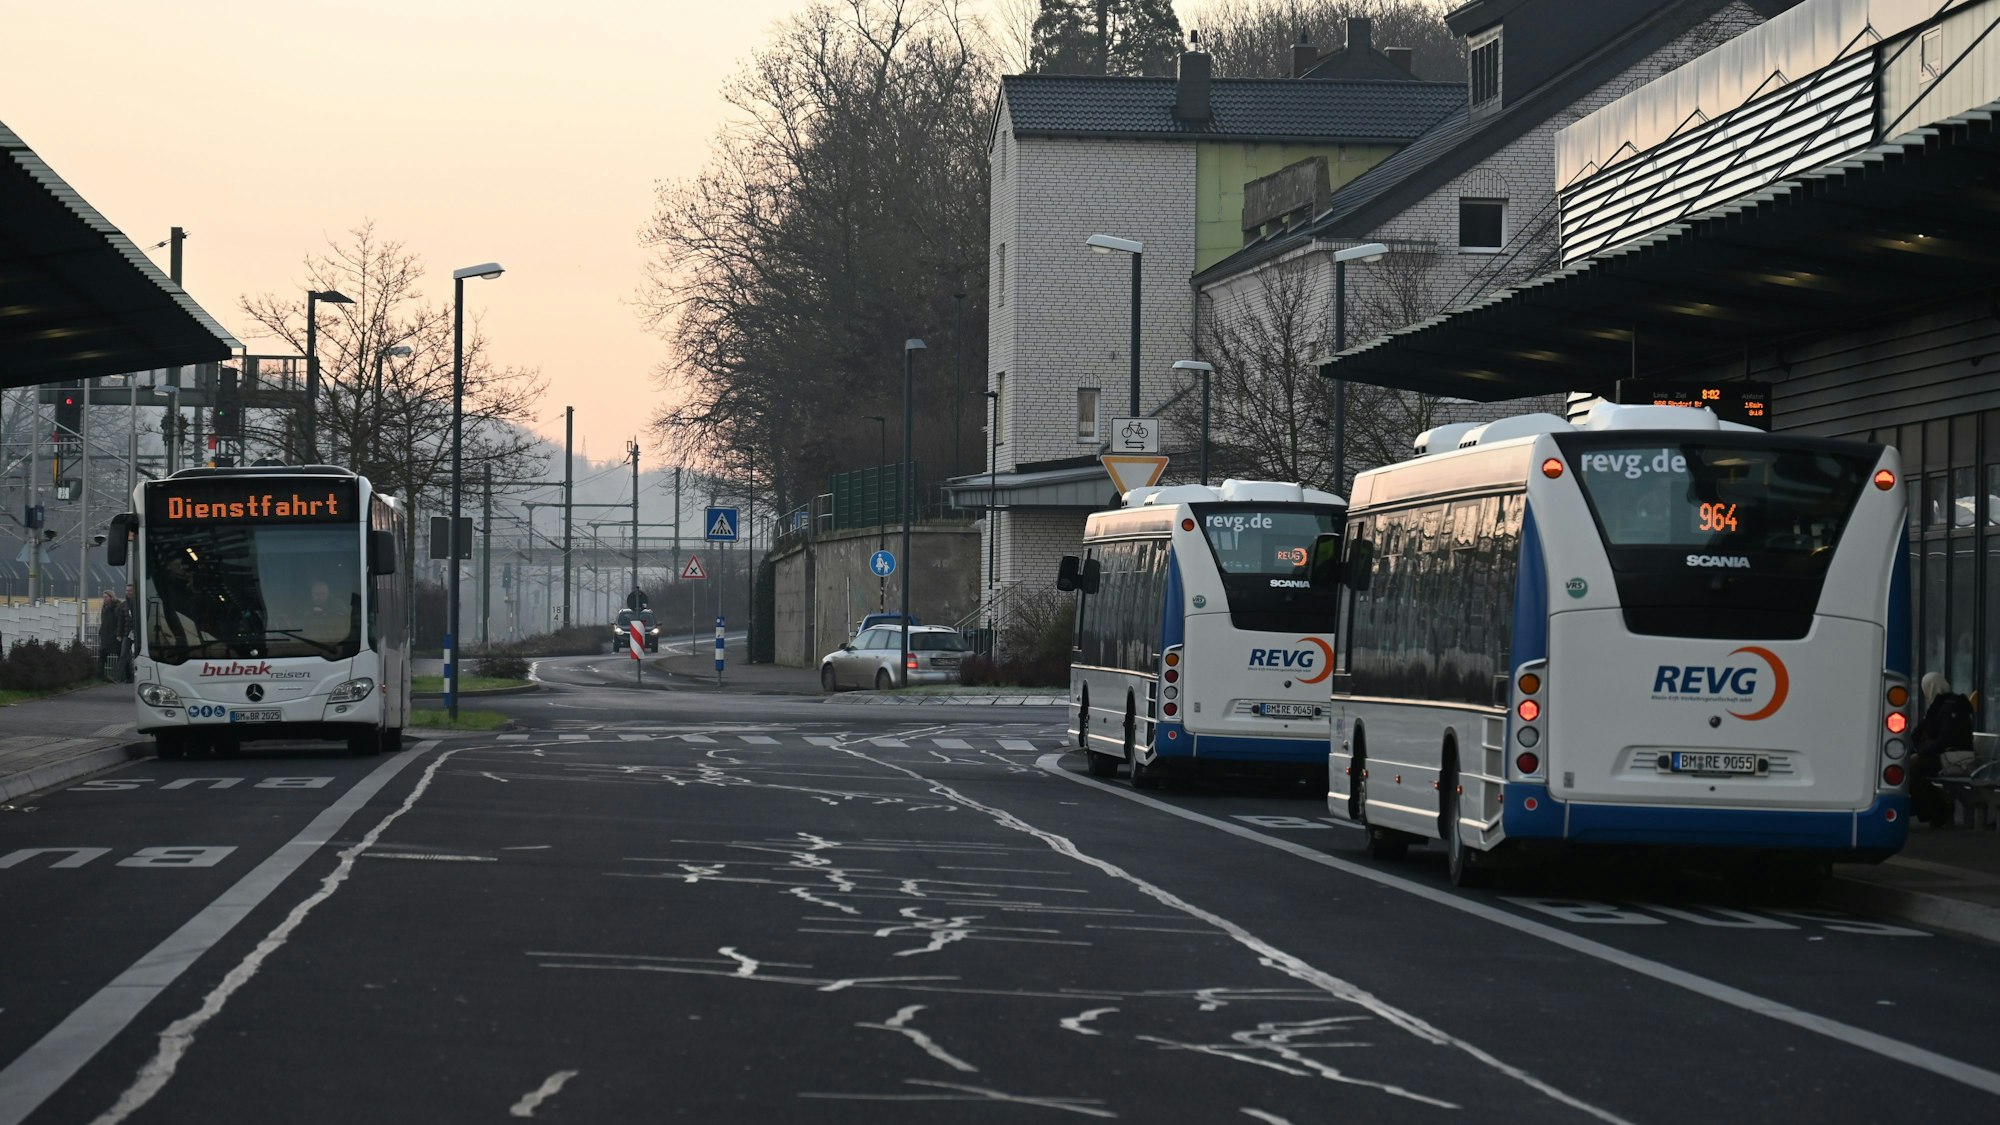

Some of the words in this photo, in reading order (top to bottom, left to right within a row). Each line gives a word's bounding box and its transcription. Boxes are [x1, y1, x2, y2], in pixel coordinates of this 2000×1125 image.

[1702, 389, 1720, 400] 8:02
[1581, 448, 1687, 479] revg.de
[168, 493, 338, 519] Dienstfahrt
[1206, 512, 1272, 532] revg.de
[1700, 503, 1737, 531] 964
[1686, 554, 1751, 568] SCANIA
[1270, 580, 1310, 588] SCANIA
[1566, 581, 1583, 590] VRS
[1249, 648, 1314, 668] REVG
[199, 660, 272, 677] bubak
[270, 669, 311, 679] reisen
[1653, 665, 1757, 695] REVG
[250, 712, 260, 720] BR
[261, 712, 280, 720] 2025
[1266, 705, 1277, 714] BM
[1281, 706, 1291, 714] RE
[1293, 706, 1312, 715] 9045
[1681, 755, 1697, 768] BM
[1705, 756, 1720, 769] RE
[1723, 756, 1753, 770] 9055
